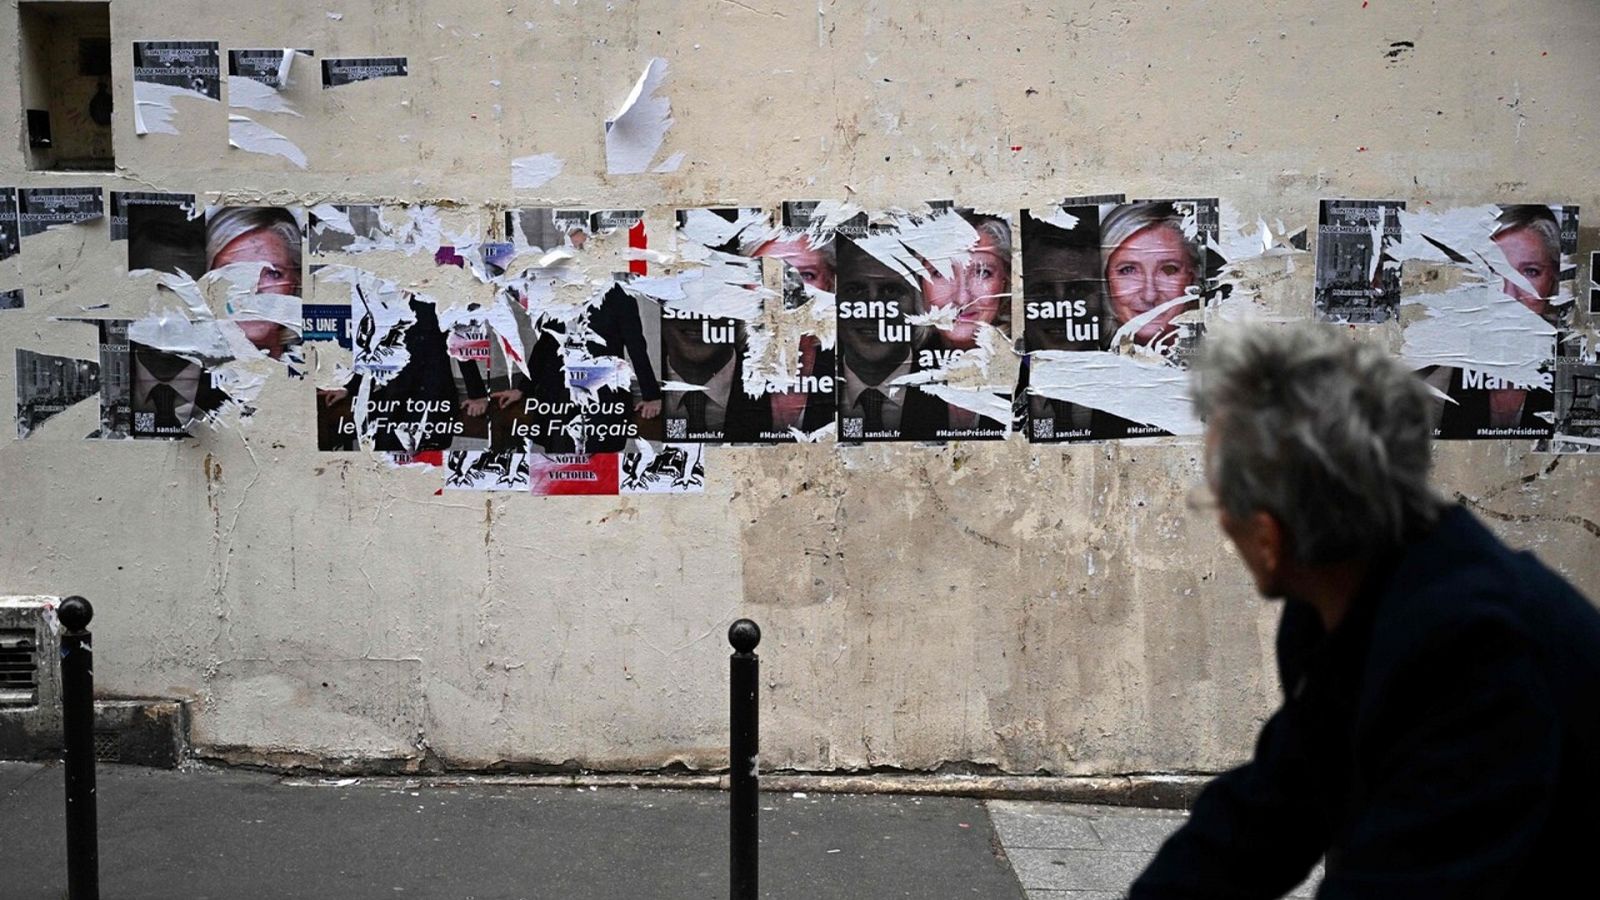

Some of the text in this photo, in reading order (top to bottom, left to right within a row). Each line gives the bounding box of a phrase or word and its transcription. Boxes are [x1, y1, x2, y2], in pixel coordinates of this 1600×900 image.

[839, 300, 899, 320] sans
[1026, 299, 1087, 320] sans
[316, 318, 338, 332] UNE
[702, 319, 735, 344] lui
[878, 318, 911, 343] lui
[1065, 316, 1100, 342] lui
[919, 349, 967, 368] ave
[570, 371, 588, 380] VIE
[406, 397, 450, 413] tous
[524, 398, 575, 415] Pour
[337, 416, 356, 434] le
[511, 418, 638, 442] les Frnçais
[936, 427, 1006, 439] #MarinePrésident
[1477, 425, 1549, 437] #MarinePrésidente
[688, 431, 725, 441] sanslui.fr
[864, 430, 901, 439] sanslui.fr
[1055, 430, 1092, 439] sanslui.fr
[556, 455, 590, 465] NOTRE
[548, 471, 596, 480] VICTOIRE
